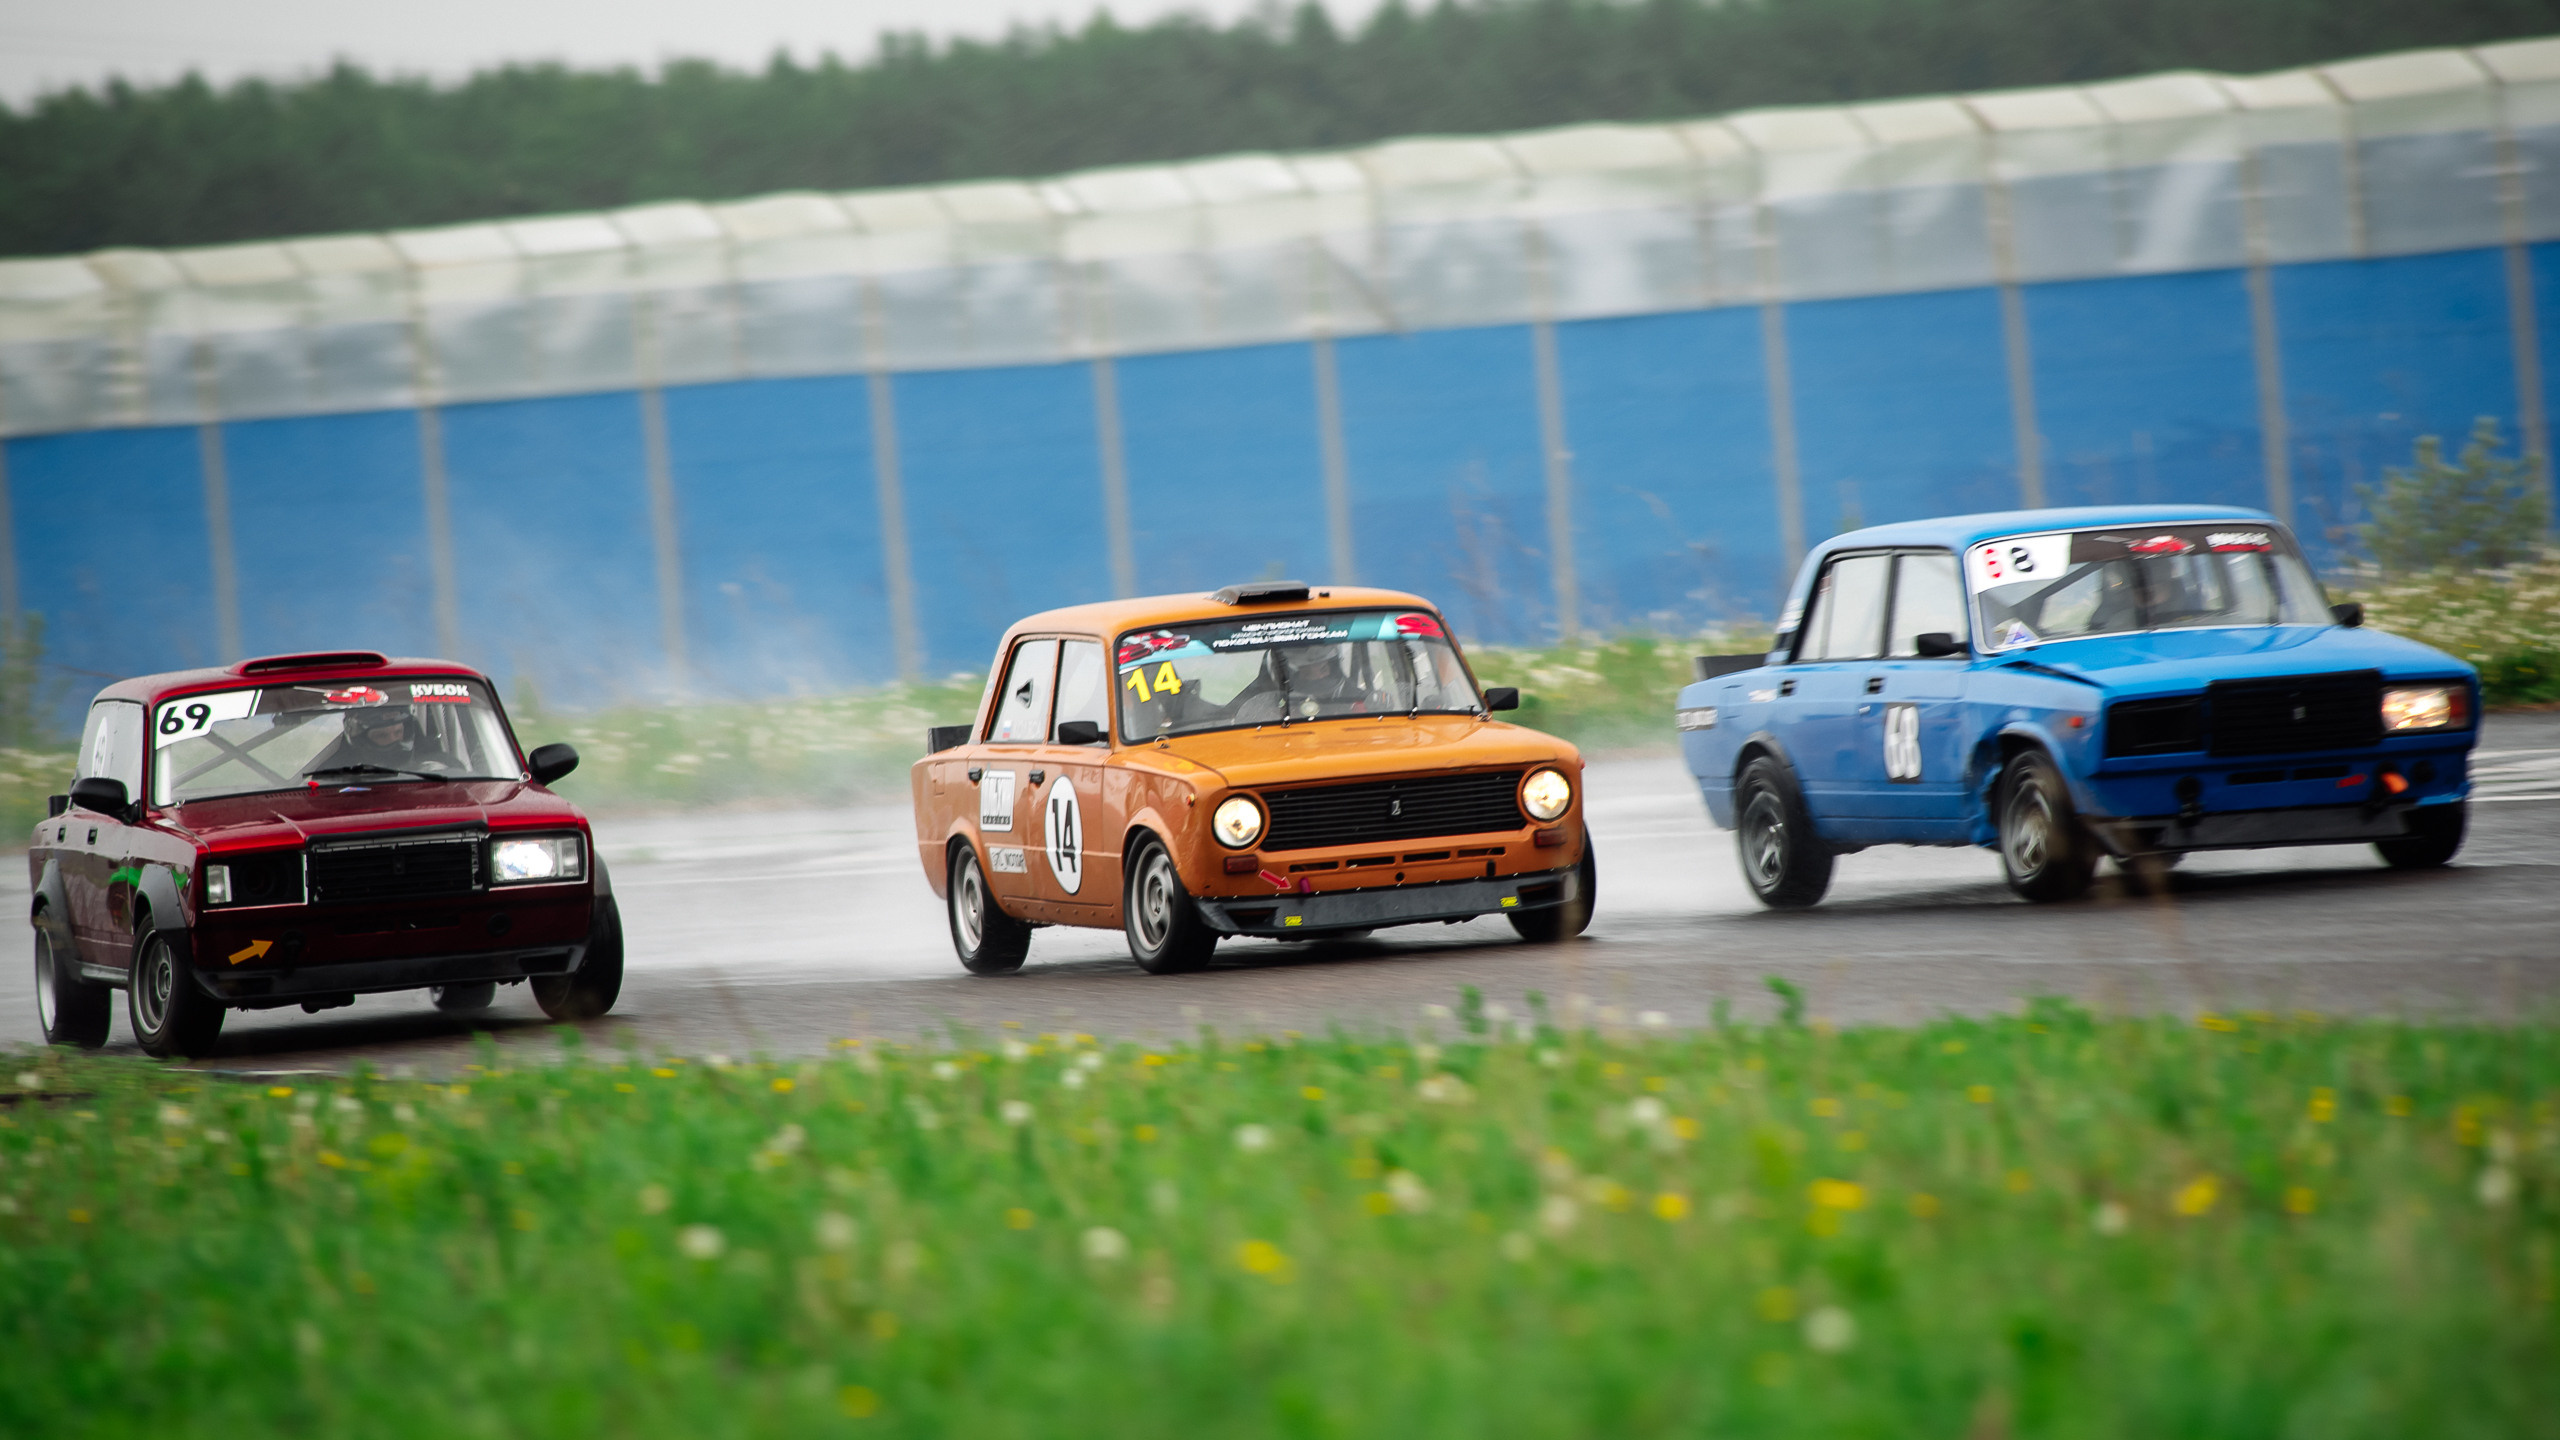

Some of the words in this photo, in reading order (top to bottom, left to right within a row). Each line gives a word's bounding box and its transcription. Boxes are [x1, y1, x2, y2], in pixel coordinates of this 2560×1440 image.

[1984, 547, 2036, 578] 68
[409, 684, 469, 696] КУБОК
[1127, 661, 1182, 703] 14
[160, 704, 211, 734] 69
[1884, 706, 1921, 779] 68
[1052, 799, 1077, 873] 14
